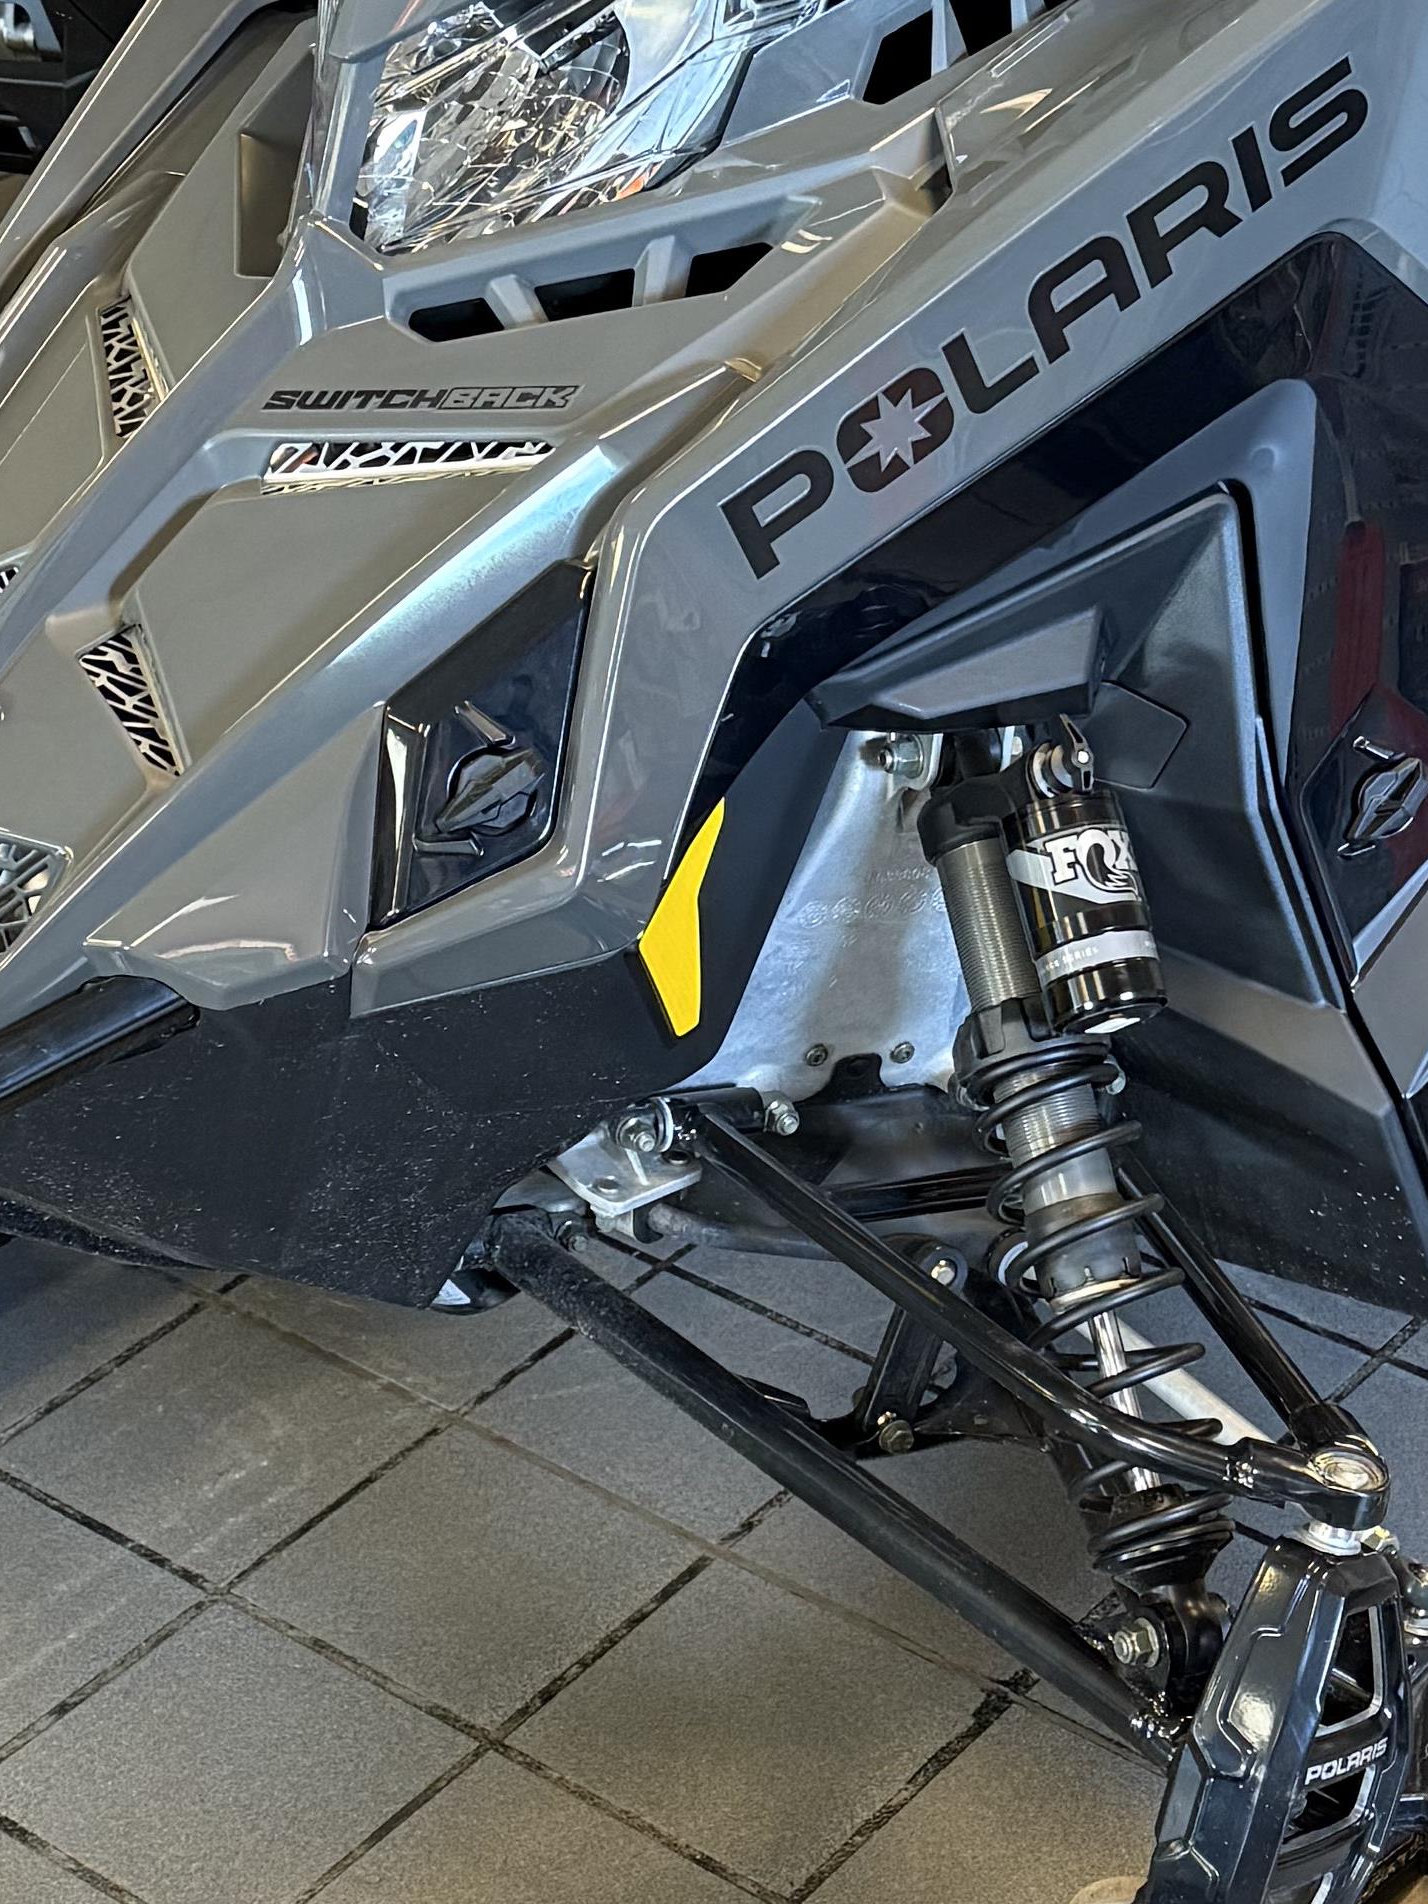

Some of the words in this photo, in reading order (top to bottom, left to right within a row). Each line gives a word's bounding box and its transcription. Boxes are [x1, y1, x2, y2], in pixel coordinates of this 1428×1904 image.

[717, 56, 1369, 581] POLARIS
[261, 383, 580, 411] SWITCHBACK
[1044, 829, 1139, 899] FOX
[1304, 1737, 1389, 1786] POLARIS
